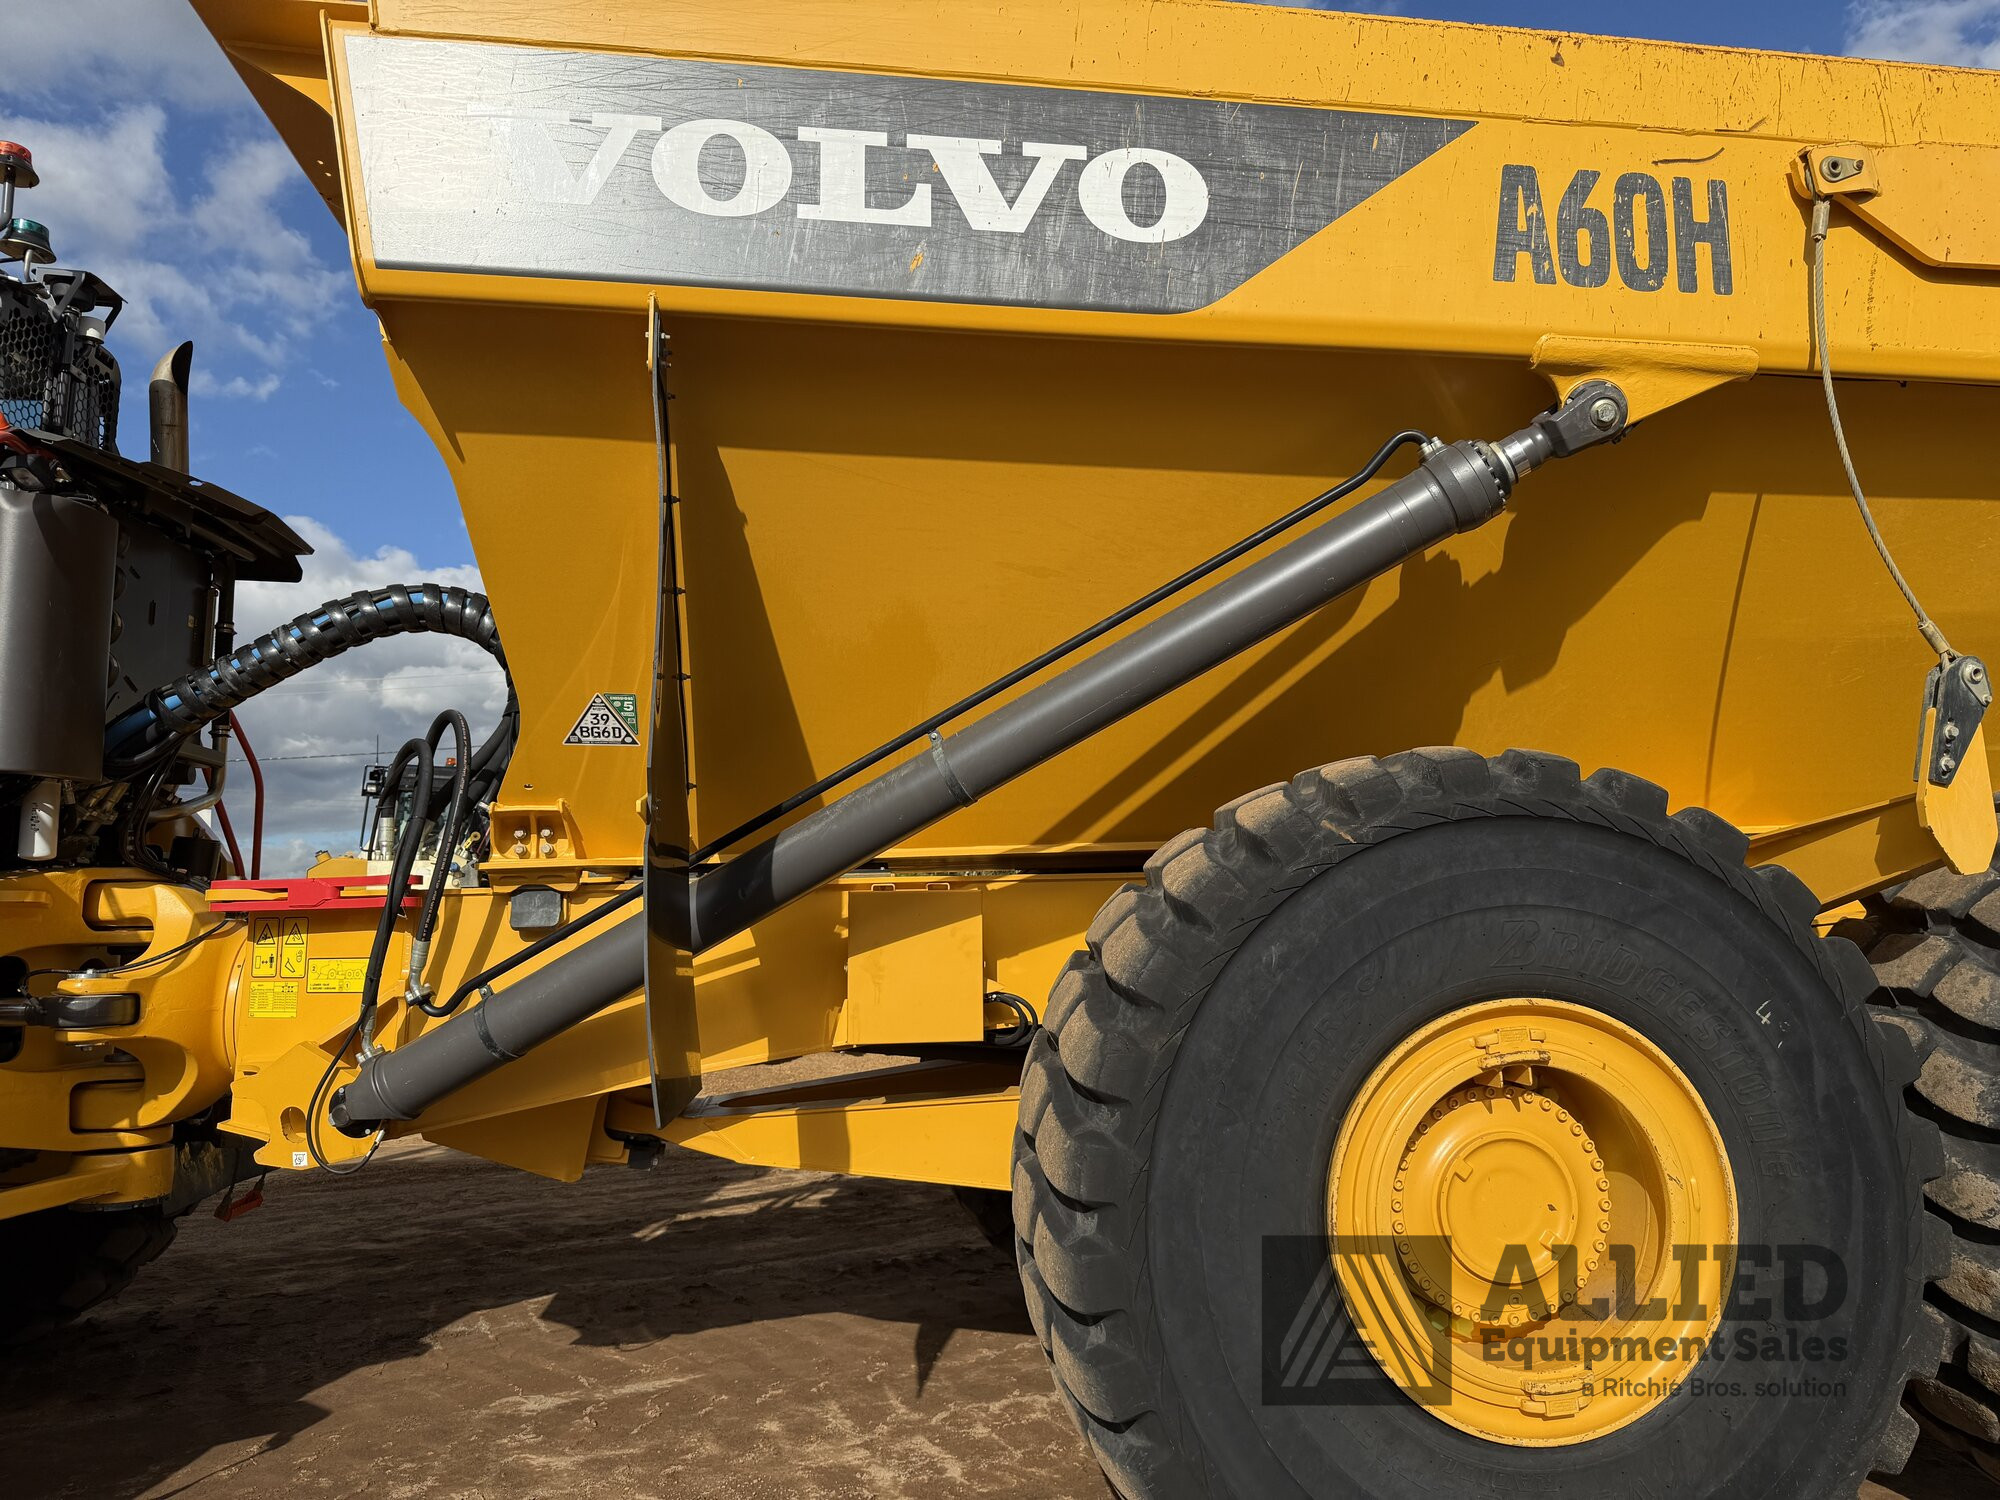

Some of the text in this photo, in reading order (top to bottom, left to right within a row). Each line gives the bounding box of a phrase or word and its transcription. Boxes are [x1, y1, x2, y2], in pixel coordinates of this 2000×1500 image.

[466, 104, 1209, 243] VOLVO
[1493, 164, 1733, 295] A60H
[580, 726, 621, 738] BG6D
[590, 713, 610, 725] 39
[623, 701, 634, 711] 5
[1490, 919, 1807, 1178] BRIDGESTONE
